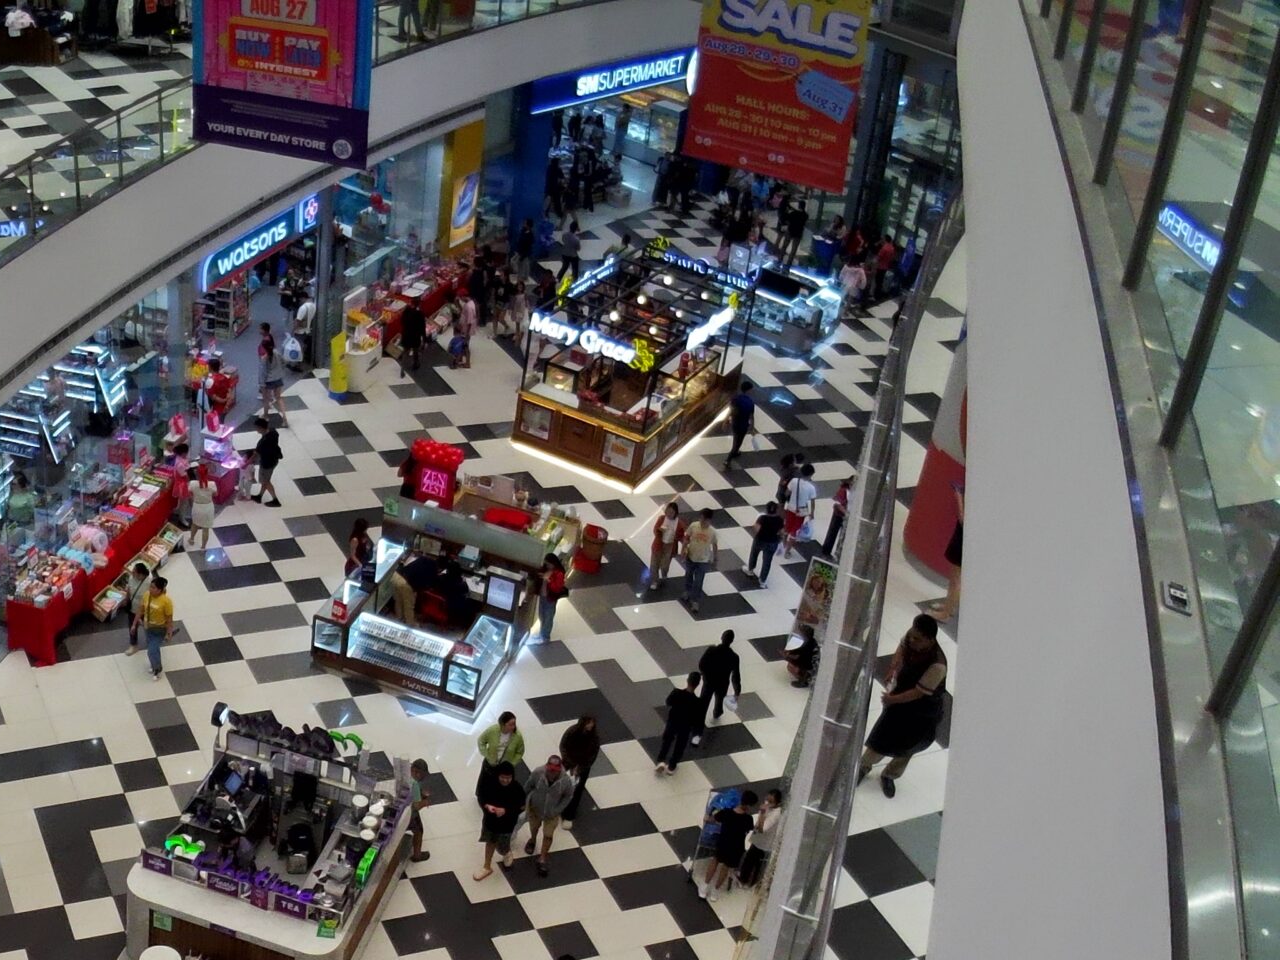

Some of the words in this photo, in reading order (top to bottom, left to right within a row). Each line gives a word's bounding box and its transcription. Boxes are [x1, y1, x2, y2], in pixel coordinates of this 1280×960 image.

[249, 0, 280, 17] AUG
[286, 0, 308, 20] 27
[235, 29, 270, 42] BUY
[721, 0, 862, 56] SALE
[284, 37, 320, 50] PAY
[255, 61, 318, 78] INTEREST
[207, 122, 235, 136] YOUR
[236, 127, 269, 140] EVERY
[270, 133, 291, 144] DAY
[291, 136, 326, 150] STORE
[217, 221, 287, 275] watsons
[529, 311, 578, 346] Mary
[579, 329, 638, 364] Grace
[422, 468, 448, 486] ZEN
[422, 482, 446, 498] ZEST
[281, 901, 300, 913] TEA
